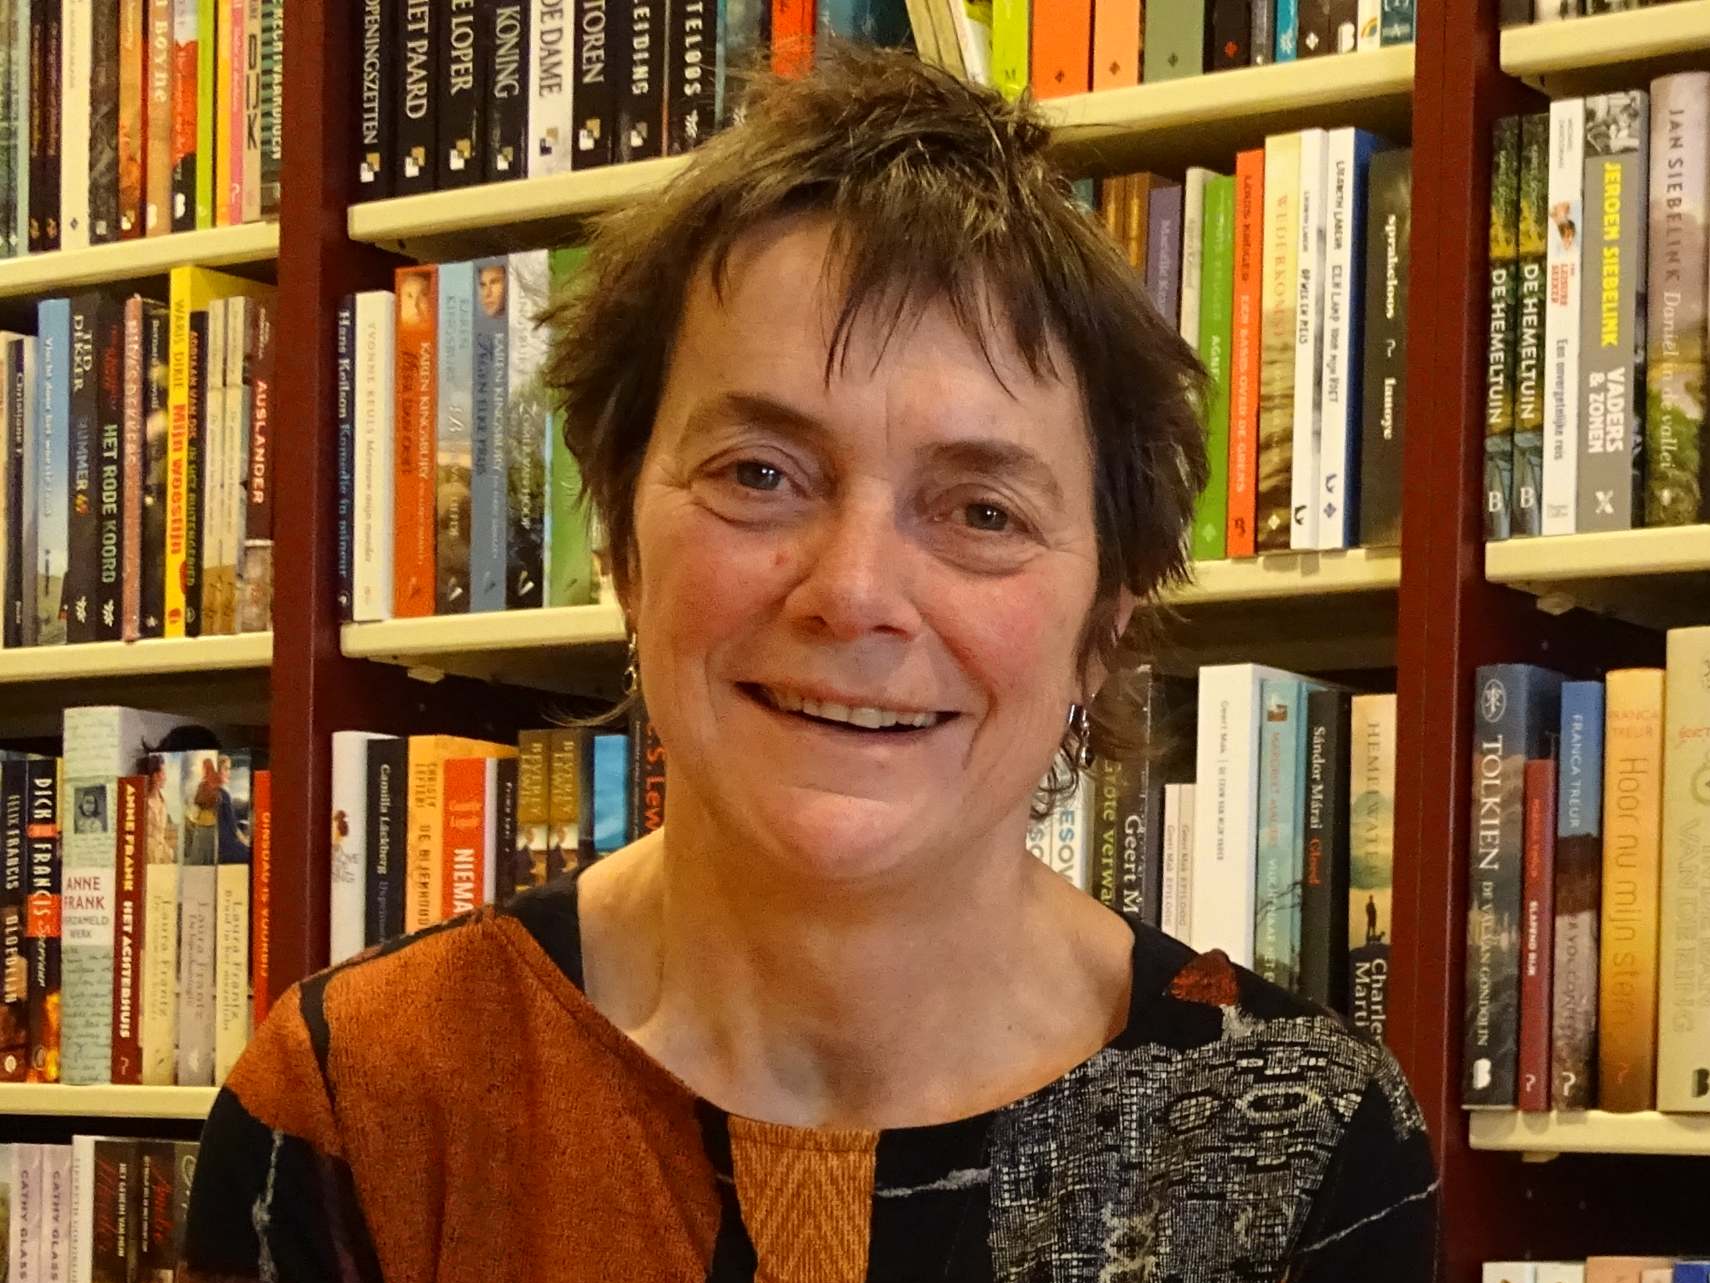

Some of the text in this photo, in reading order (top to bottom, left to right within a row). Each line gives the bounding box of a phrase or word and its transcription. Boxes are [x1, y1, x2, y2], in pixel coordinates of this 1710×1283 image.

[406, 39, 428, 119] PAARD
[450, 7, 474, 95] LOPER
[495, 5, 520, 98] KONING
[1601, 160, 1622, 348] JEROEN SIEBELINK
[251, 380, 267, 503] AUSLANDER
[1588, 391, 1604, 454] ZONEN
[1605, 367, 1626, 453] VADERS
[102, 424, 119, 582] HET RODE KOORD
[1480, 734, 1505, 870] TOLKIEN
[33, 778, 52, 925] DICK FRANCIS
[67, 876, 100, 891] ANNE
[1124, 816, 1141, 883] Geert
